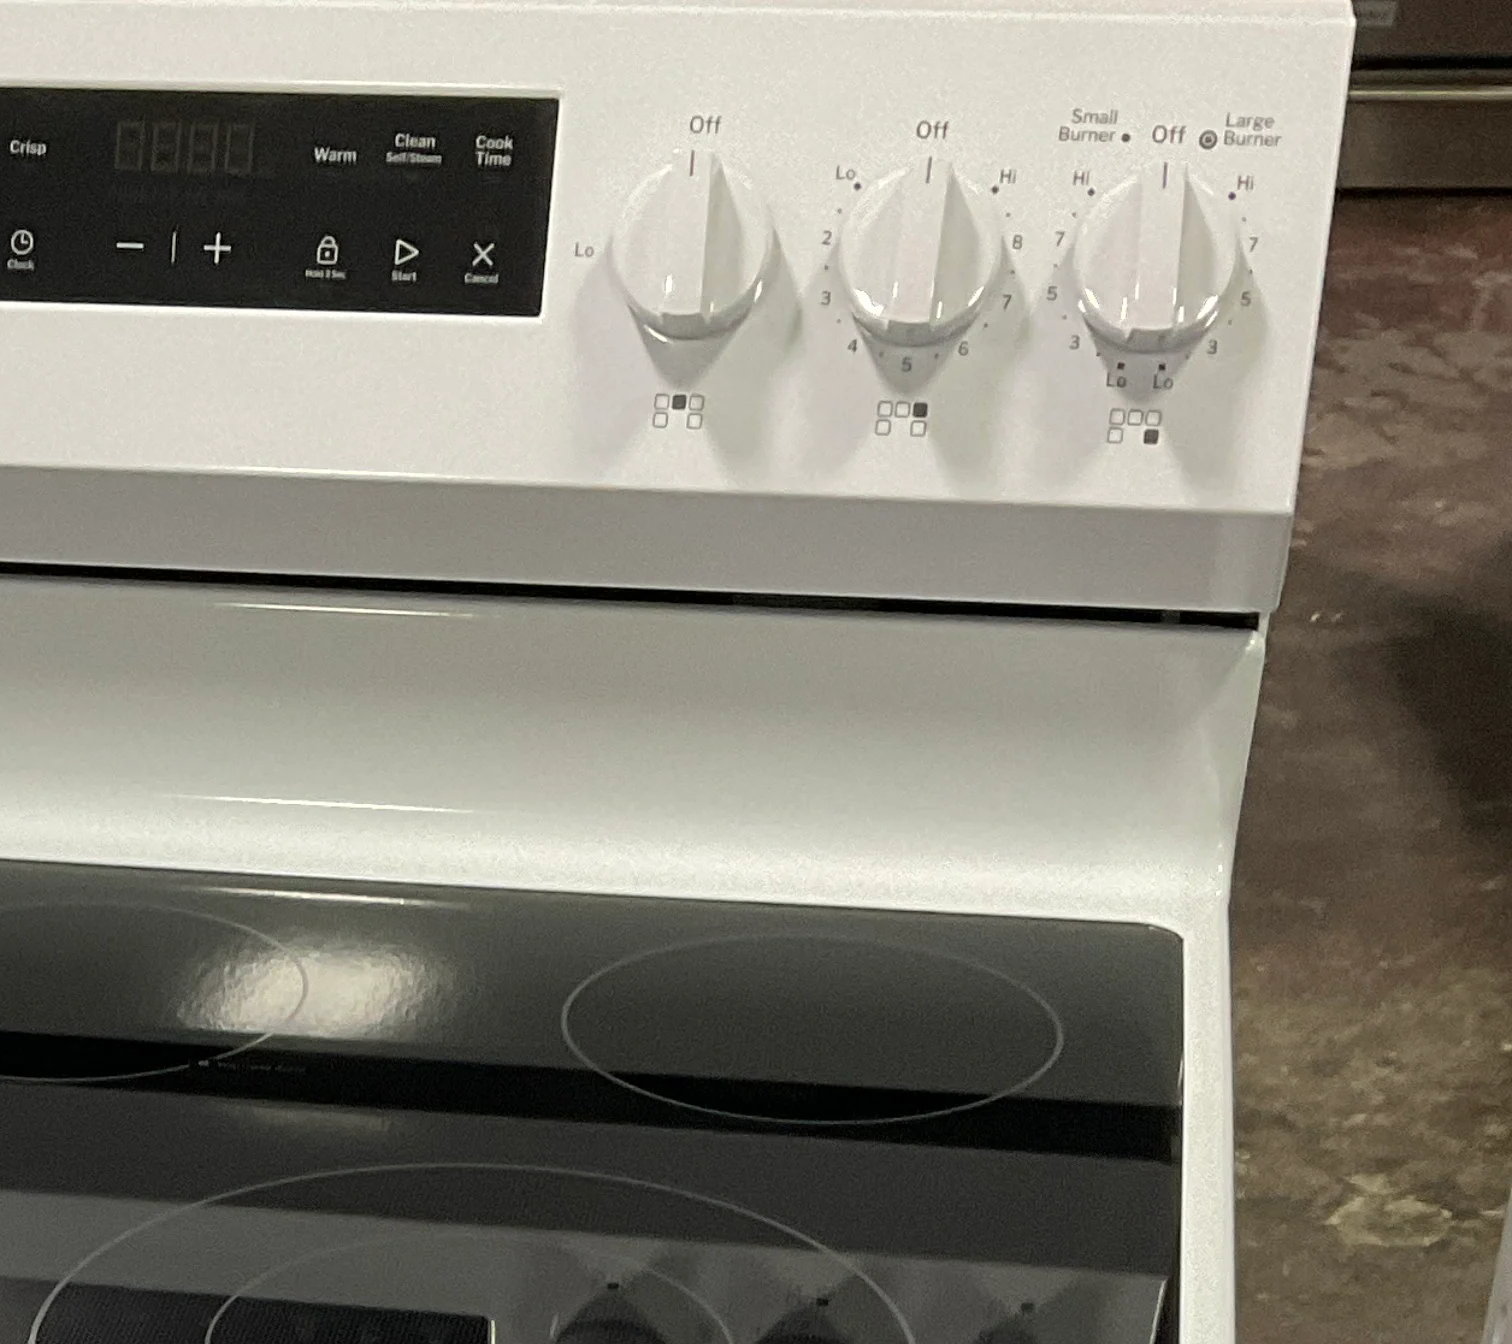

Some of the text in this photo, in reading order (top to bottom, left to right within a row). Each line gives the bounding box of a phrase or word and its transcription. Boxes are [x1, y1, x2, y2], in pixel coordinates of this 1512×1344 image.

[1071, 107, 1119, 126] Small
[1225, 112, 1275, 131] Large
[689, 115, 721, 135] Off
[916, 120, 949, 140] Off
[395, 133, 436, 149] Clean
[475, 135, 514, 150] Cook
[1058, 126, 1116, 143] Burner
[1151, 125, 1187, 145] Off
[1223, 130, 1282, 148] Burner
[10, 140, 47, 157] Crisp
[314, 147, 357, 164] Warm
[475, 151, 512, 167] Time
[835, 165, 856, 181] Lo
[999, 169, 1017, 185] Hi
[1072, 170, 1090, 186] Hi
[1238, 175, 1254, 191] Hi
[822, 230, 832, 246] 2
[1012, 234, 1023, 250] 8
[1056, 231, 1066, 247] 7
[1249, 237, 1259, 252] 7
[574, 241, 594, 258] Lo
[820, 291, 831, 307] 3
[1046, 286, 1058, 301] 5
[1240, 291, 1252, 307] 5
[1002, 294, 1013, 310] 7
[847, 339, 858, 353] 4
[958, 341, 969, 356] 6
[1069, 335, 1080, 350] 3
[1207, 341, 1218, 355] 3
[901, 357, 912, 373] 5
[1106, 373, 1127, 388] Lo
[1153, 374, 1174, 390] Lo
